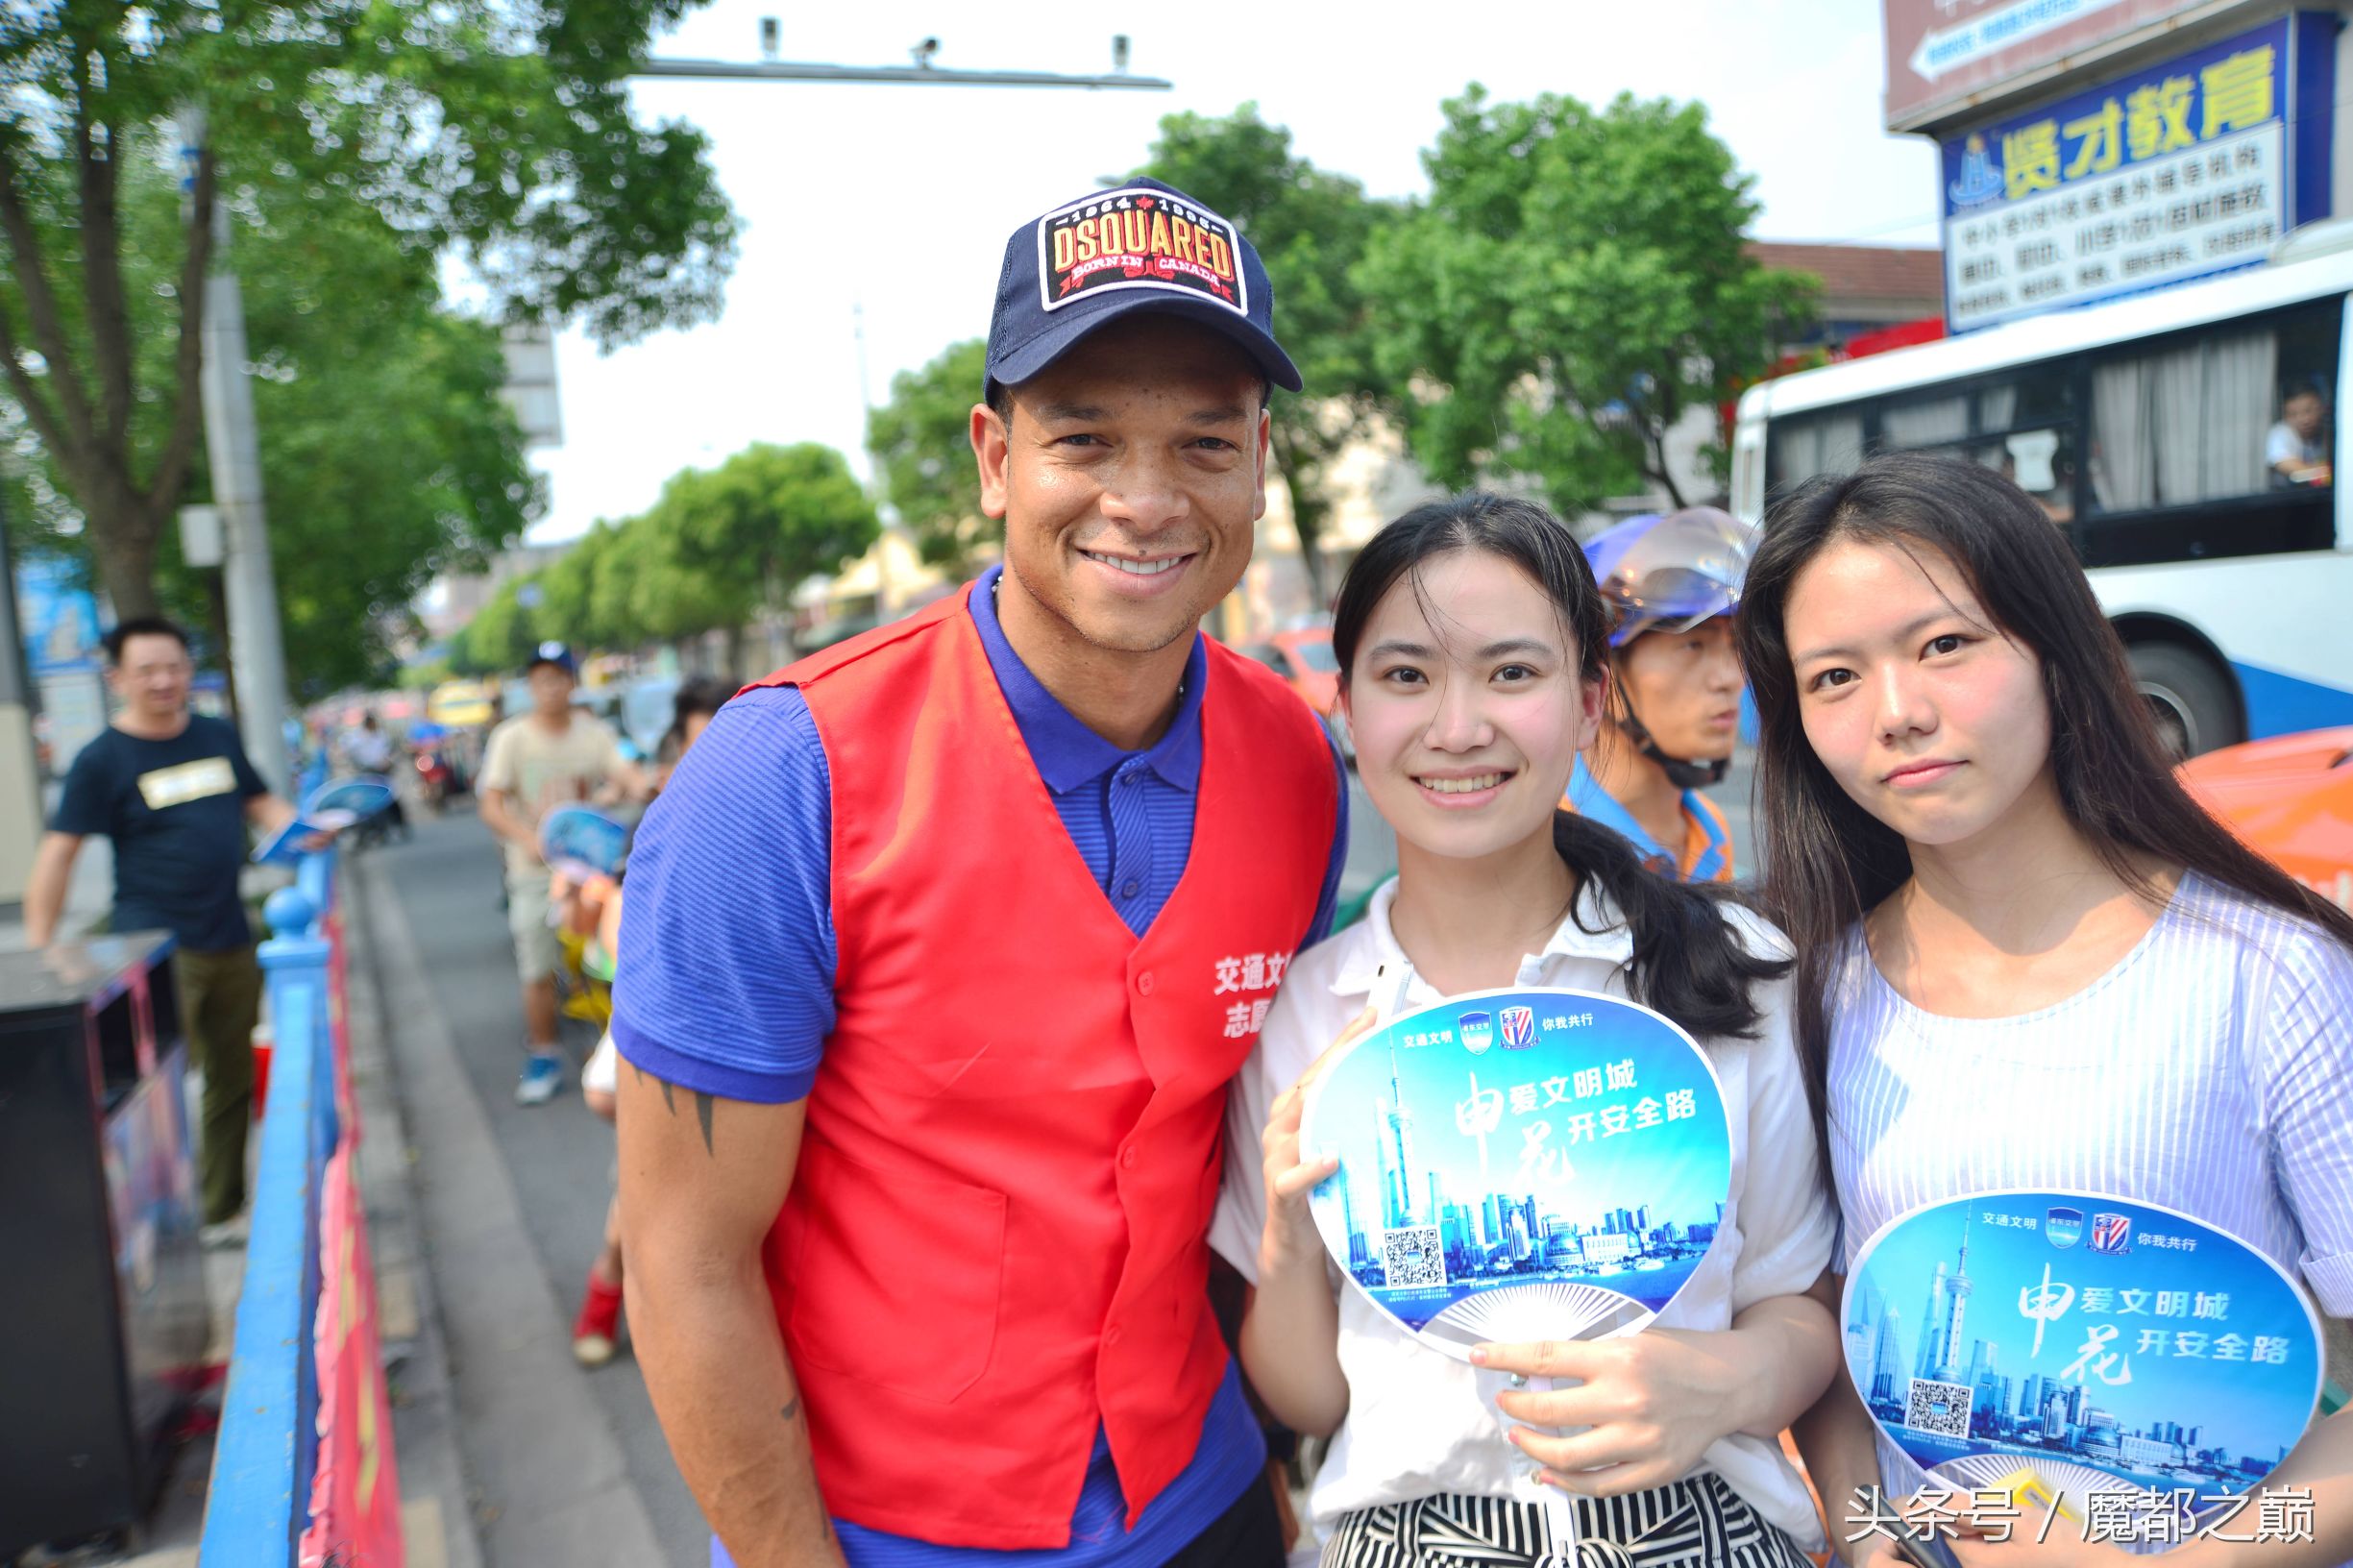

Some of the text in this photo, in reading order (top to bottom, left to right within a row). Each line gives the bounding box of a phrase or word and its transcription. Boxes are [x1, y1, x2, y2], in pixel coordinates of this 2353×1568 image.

[2002, 43, 2275, 199] 贤才教育
[1071, 196, 1132, 223] 1964
[1053, 208, 1234, 281] DSQUARED
[1071, 255, 1221, 286] BORN IN CANADA
[1213, 949, 1293, 996] 交通文
[1403, 1030, 1453, 1049] 交通文明
[1541, 1013, 1594, 1032] 你我共行
[1455, 1059, 1638, 1178] 申 爱文明城
[1567, 1088, 1698, 1146] 开安全路
[1982, 1212, 2038, 1230] 交通文明
[2137, 1232, 2198, 1252] 你我共行
[2019, 1262, 2230, 1359] 申 爱文明城
[2060, 1324, 2292, 1386] 花 开安全路
